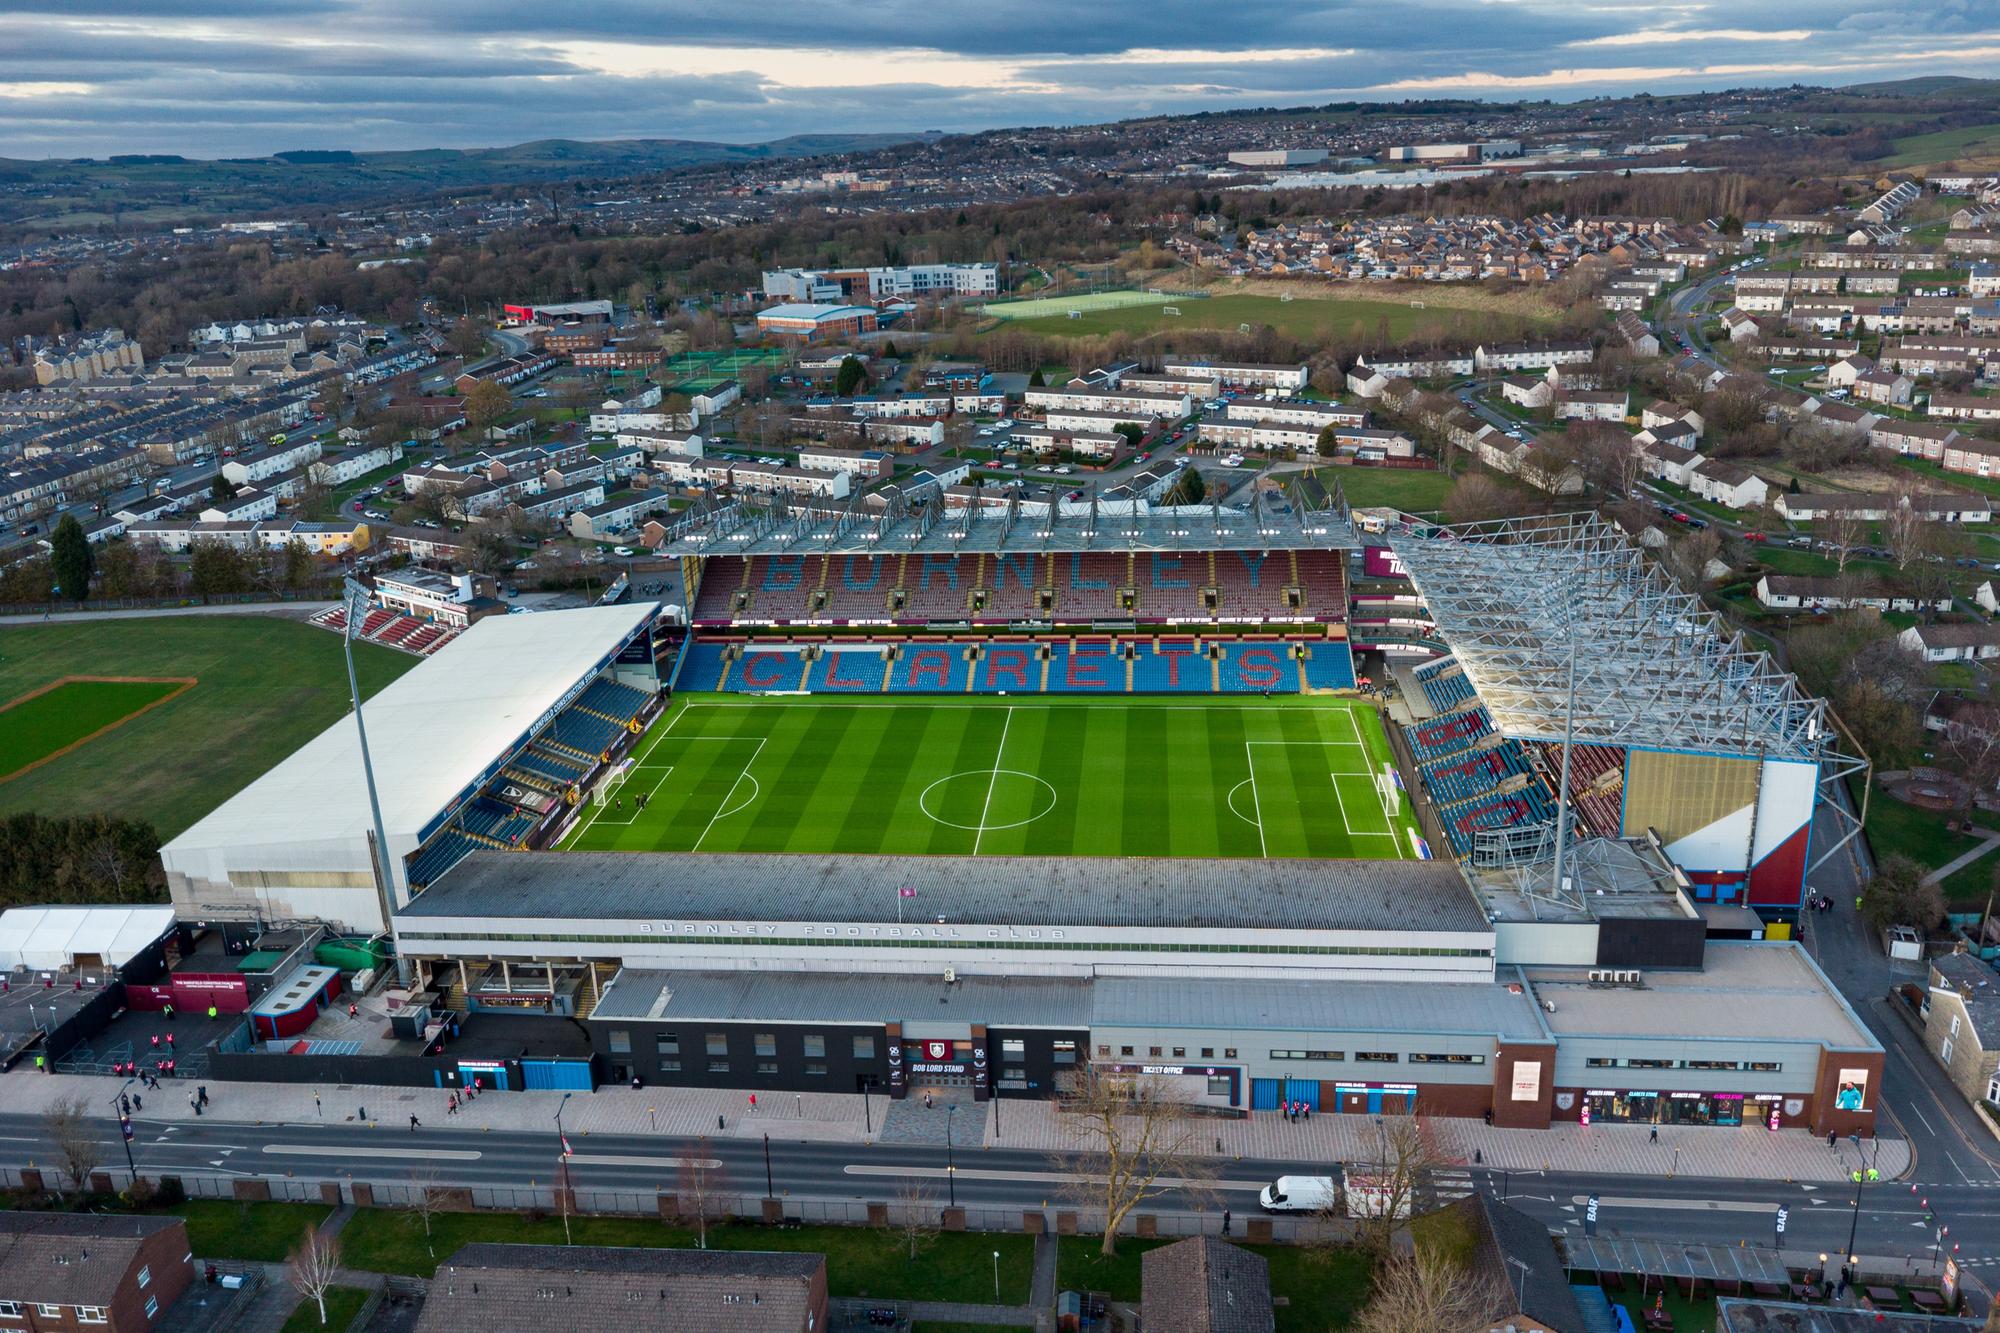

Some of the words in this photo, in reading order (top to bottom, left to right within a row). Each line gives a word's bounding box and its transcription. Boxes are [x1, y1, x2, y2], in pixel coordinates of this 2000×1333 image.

[761, 552, 1267, 592] BURNLEY
[584, 668, 598, 684] STAND
[741, 650, 1282, 688] CLARETS
[640, 924, 778, 934] BURNLEY
[804, 926, 960, 938] FOOTBALL
[988, 928, 1065, 940] CLUB
[912, 1064, 926, 1072] BOB
[944, 1065, 964, 1073] STAND
[1586, 1198, 1599, 1222] BAR
[1777, 1209, 1788, 1232] BAR
